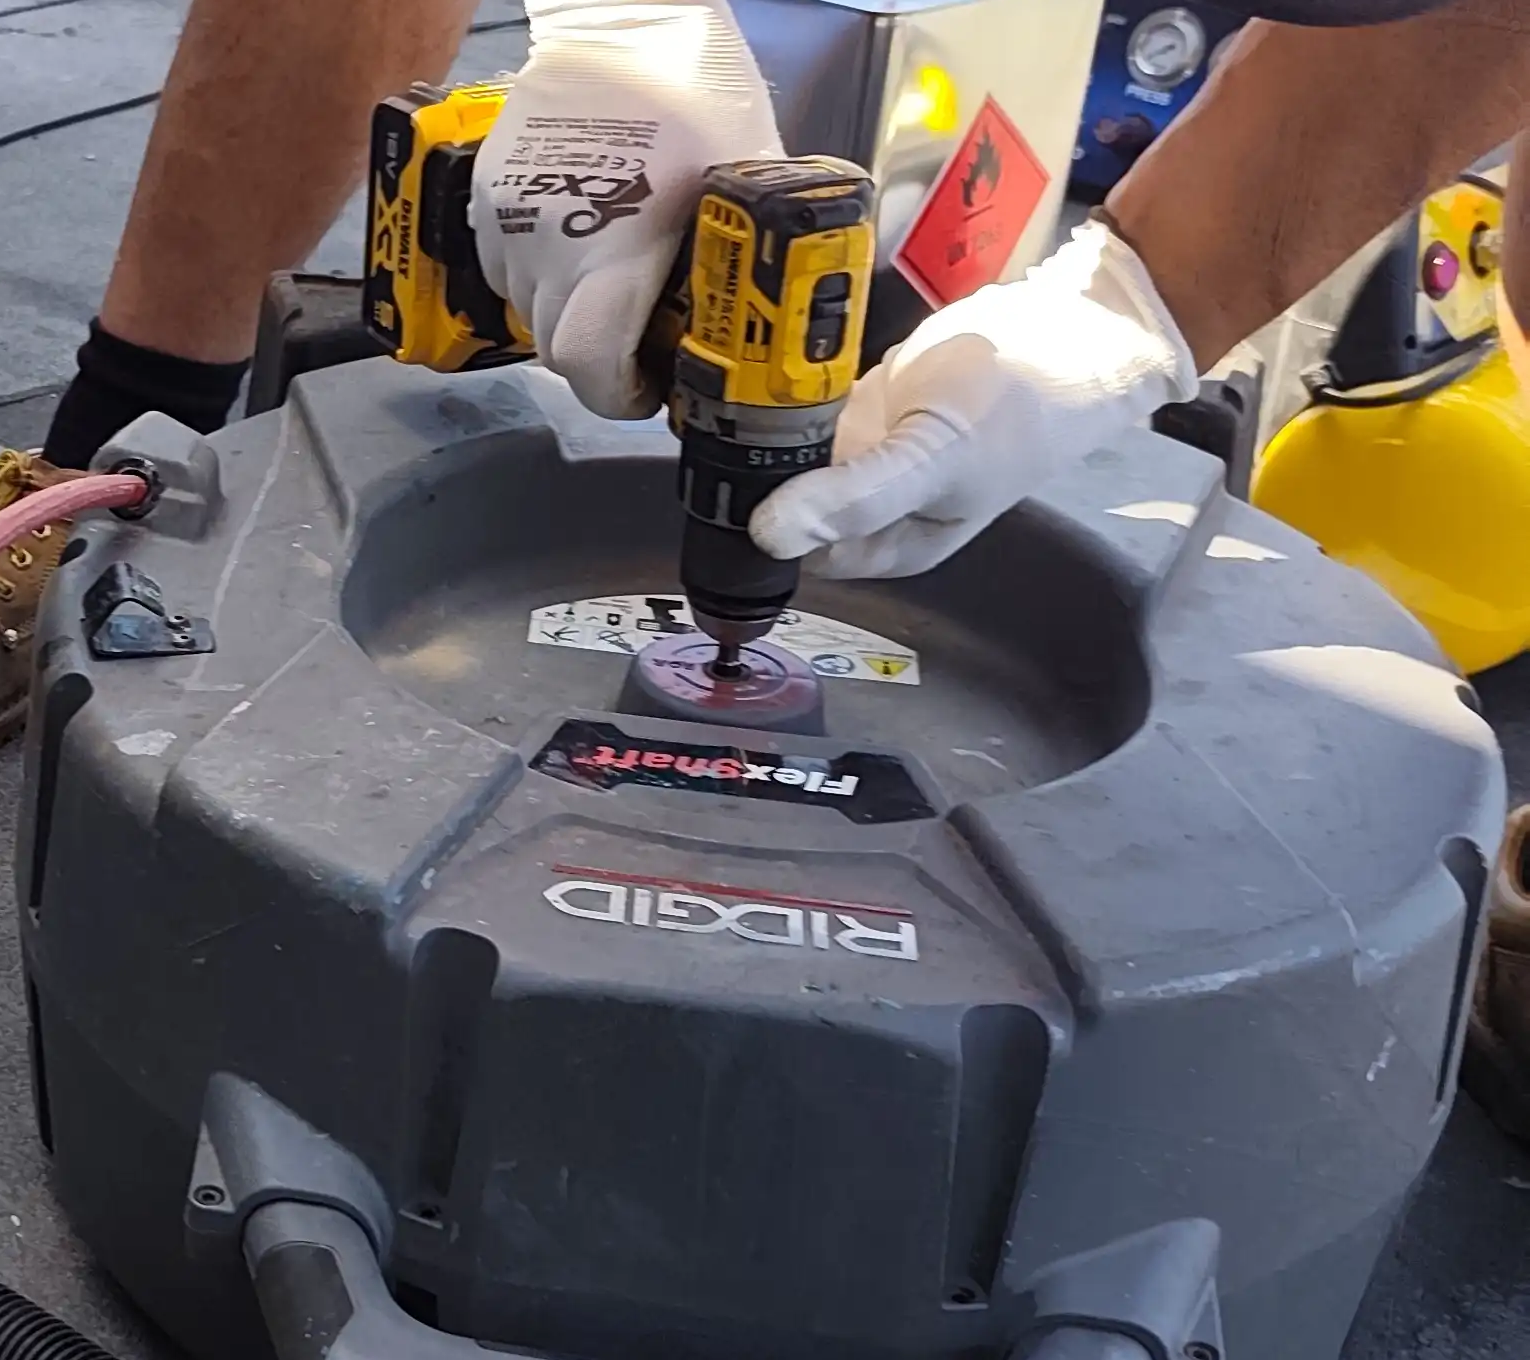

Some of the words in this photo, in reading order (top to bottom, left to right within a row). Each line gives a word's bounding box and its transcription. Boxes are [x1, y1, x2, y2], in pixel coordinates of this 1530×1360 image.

[384, 130, 400, 181] 18V
[519, 174, 634, 199] CXS
[371, 171, 400, 278] XR
[748, 449, 774, 466] 15
[542, 880, 919, 961] RIDGID
